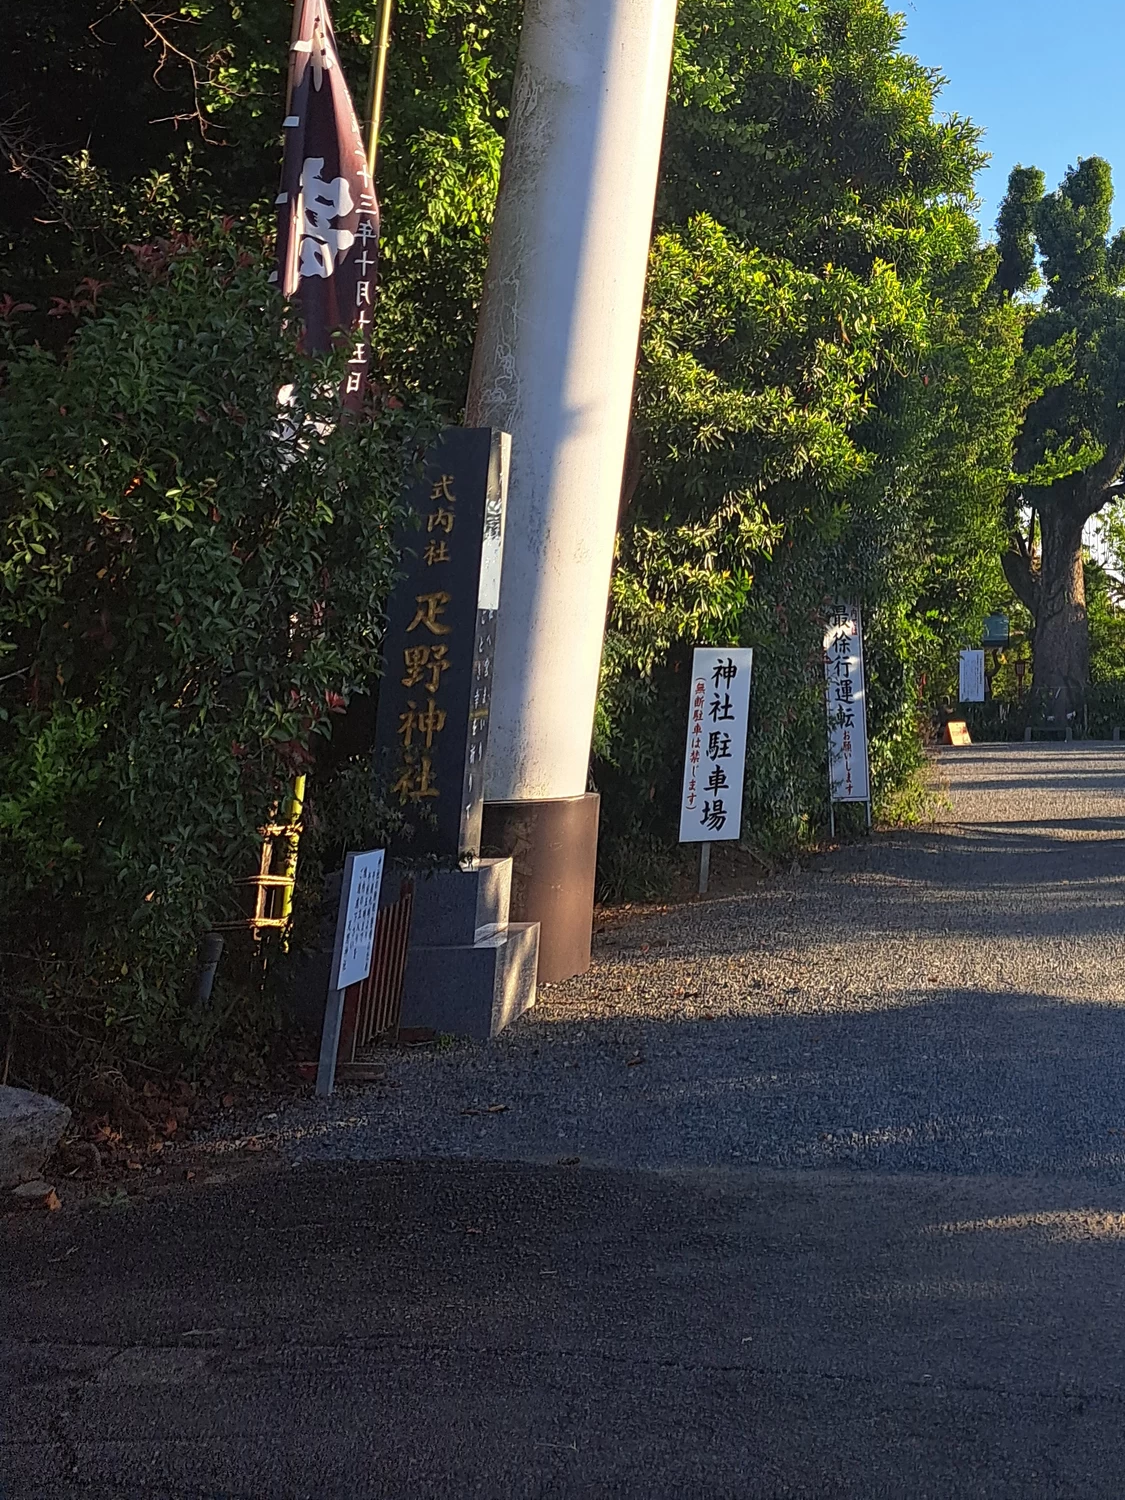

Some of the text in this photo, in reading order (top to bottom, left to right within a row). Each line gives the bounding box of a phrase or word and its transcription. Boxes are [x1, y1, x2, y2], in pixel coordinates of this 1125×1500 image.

[422, 474, 457, 567] 式内社
[391, 590, 453, 799] 疋野神社
[699, 657, 738, 832] 神社駐車場
